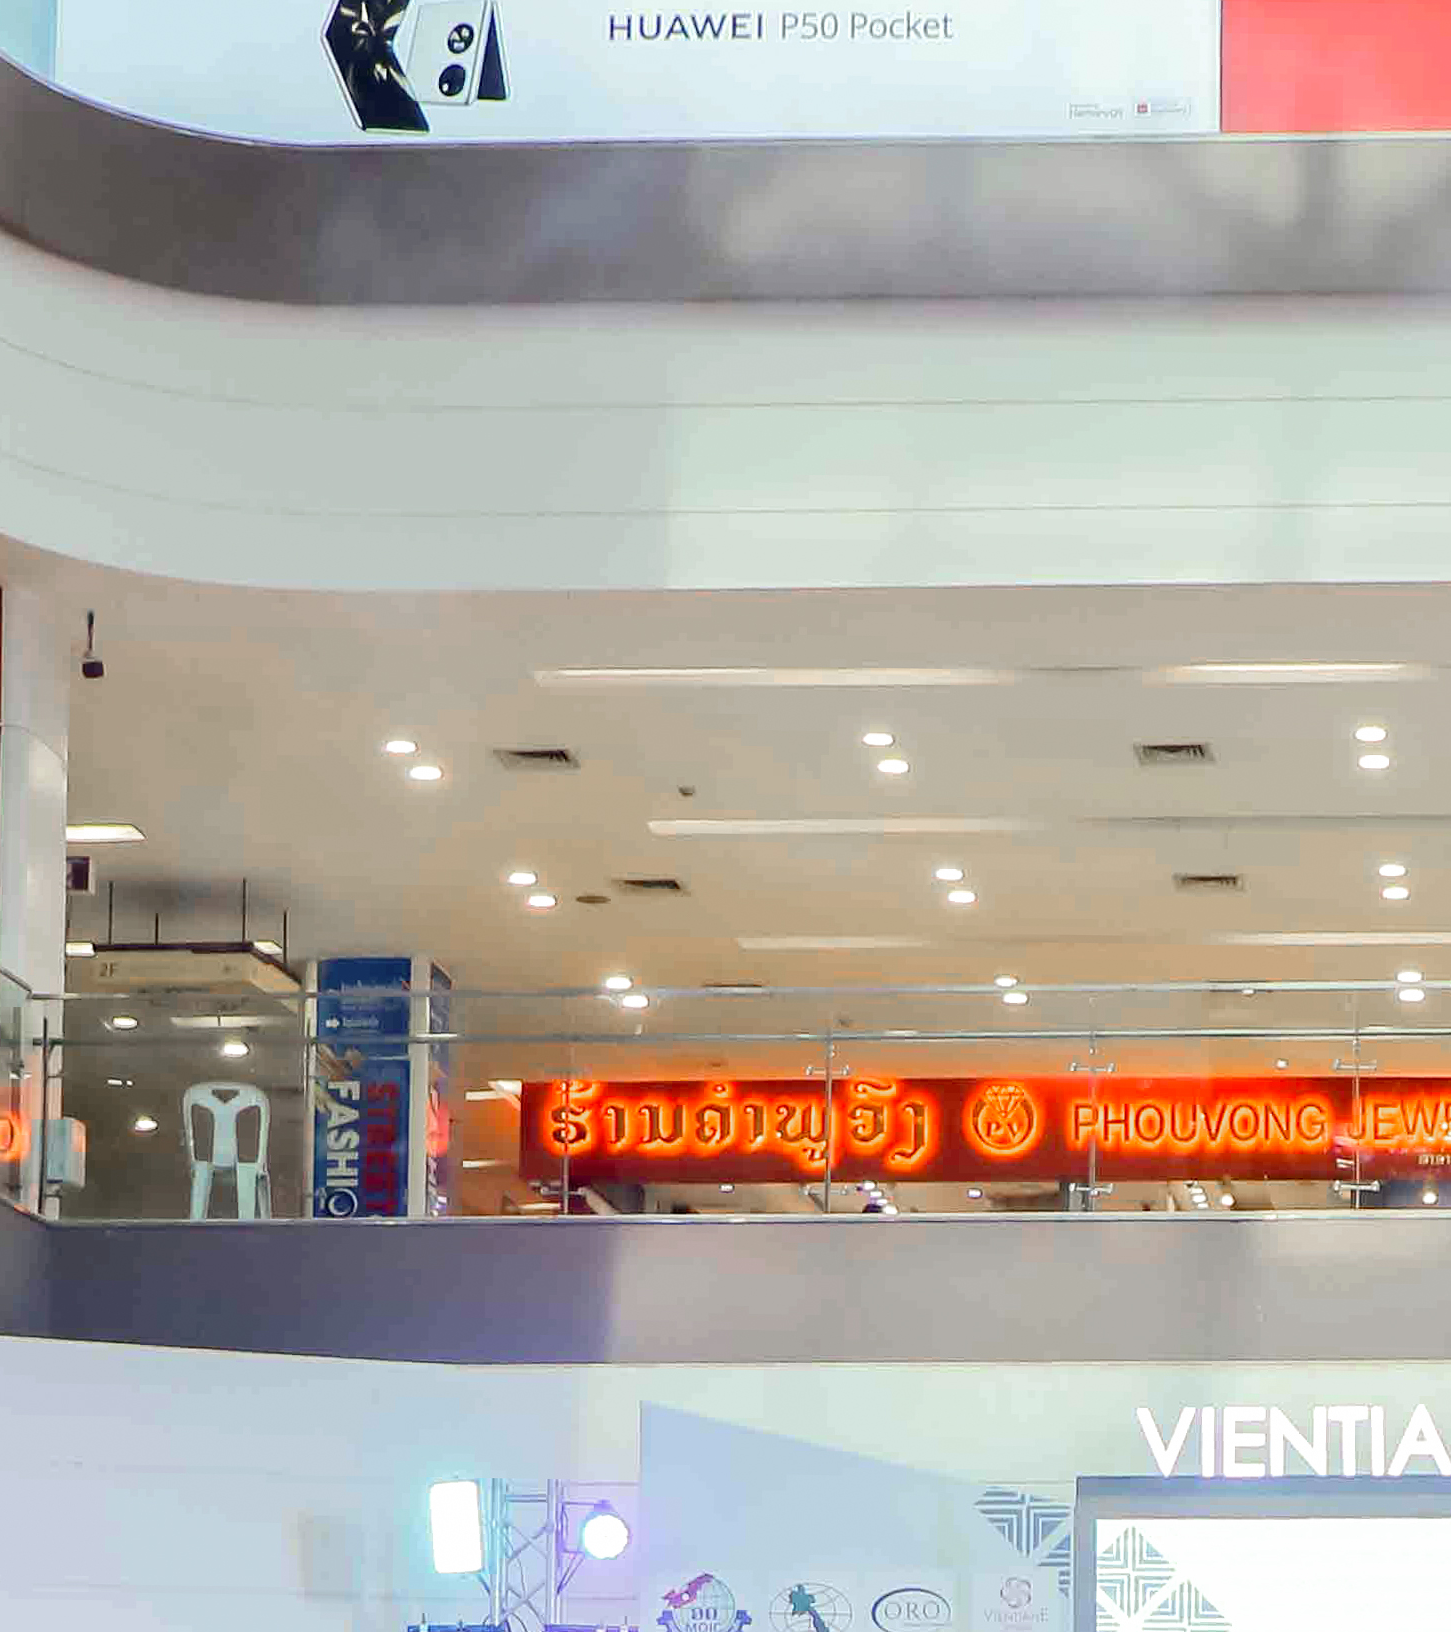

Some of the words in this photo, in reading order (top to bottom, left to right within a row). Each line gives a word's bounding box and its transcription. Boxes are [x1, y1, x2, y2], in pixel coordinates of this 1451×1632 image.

[609, 13, 763, 41] HUAWEI
[782, 12, 839, 41] P50
[850, 11, 954, 41] Pocket
[1074, 1102, 1326, 1142] PHOUVONG
[884, 1600, 941, 1621] ORO
